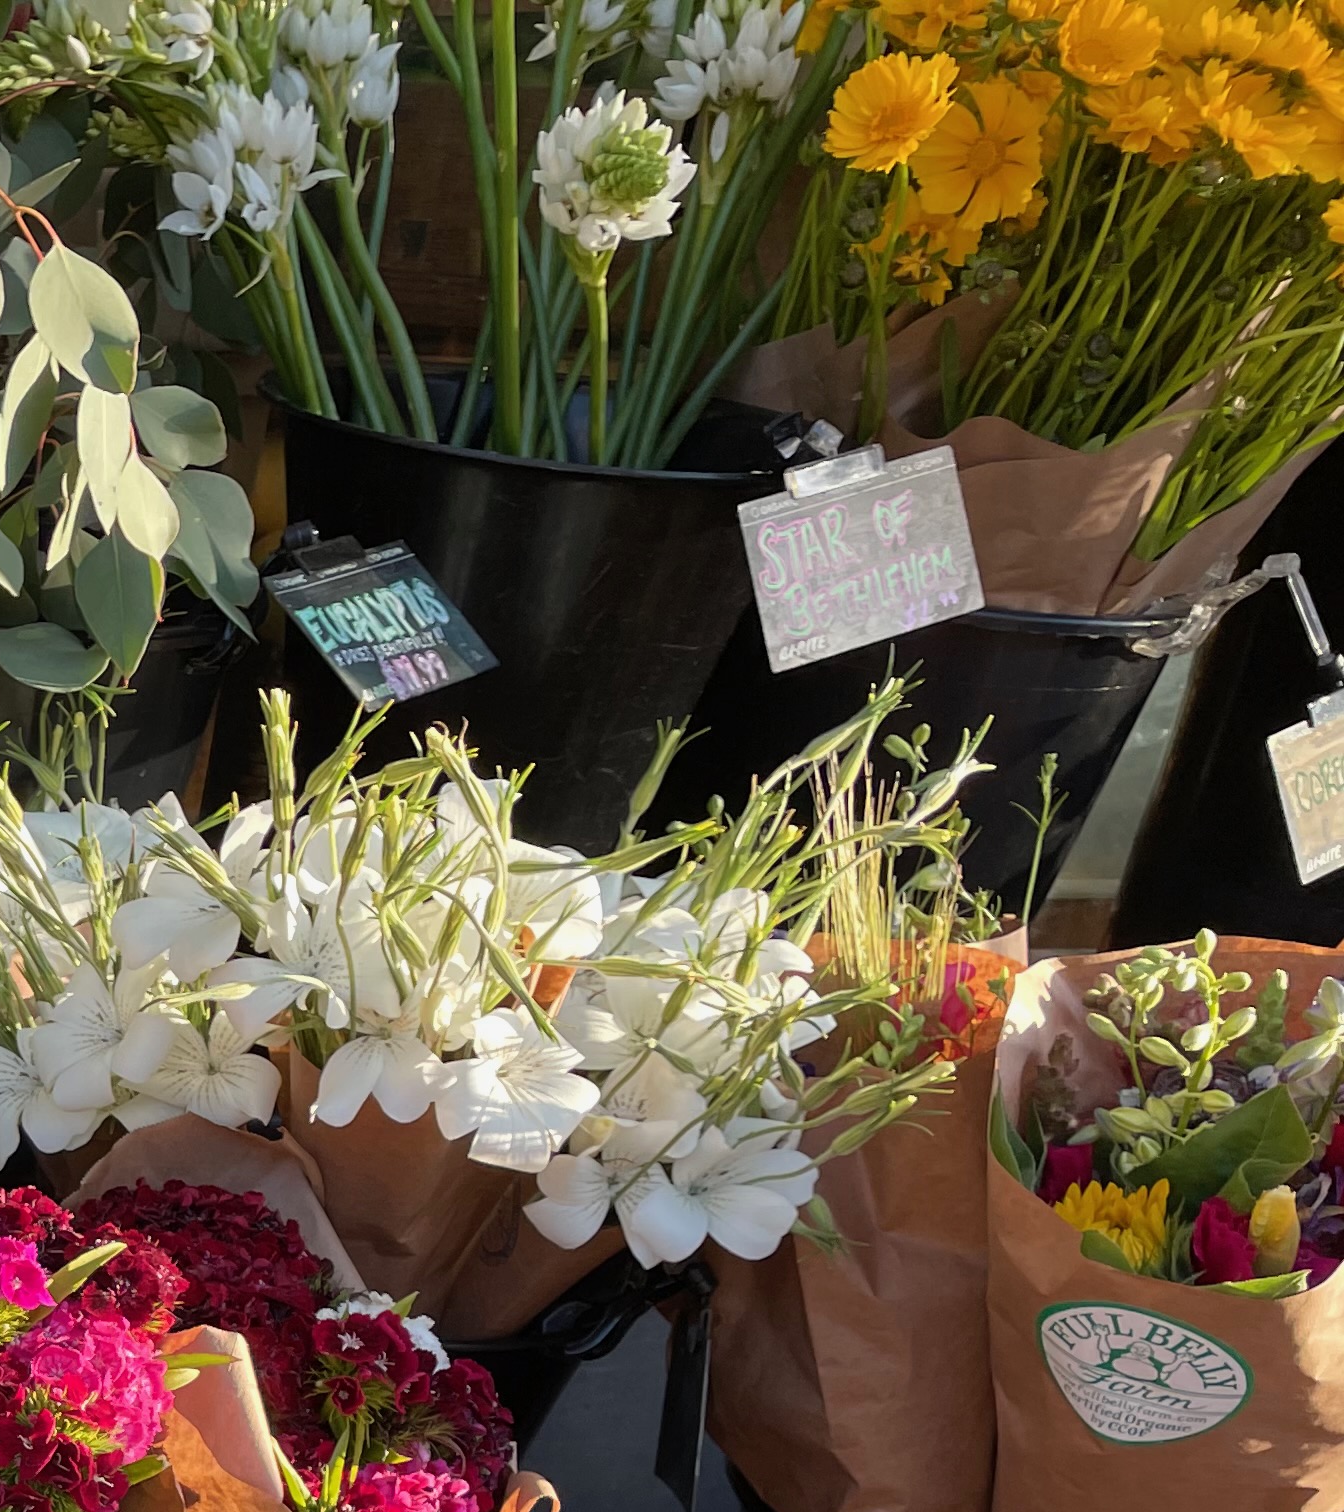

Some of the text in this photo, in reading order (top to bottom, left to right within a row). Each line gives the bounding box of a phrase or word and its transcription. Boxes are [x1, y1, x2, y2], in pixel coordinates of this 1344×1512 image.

[757, 488, 912, 598] STAR OF
[294, 577, 450, 653] EUCALYPTUS
[778, 545, 959, 638] BETHLEHEM
[1047, 1312, 1238, 1391] FULL BELLY
[1067, 1363, 1207, 1411] Farm
[1063, 1383, 1192, 1434] Certified Organic
